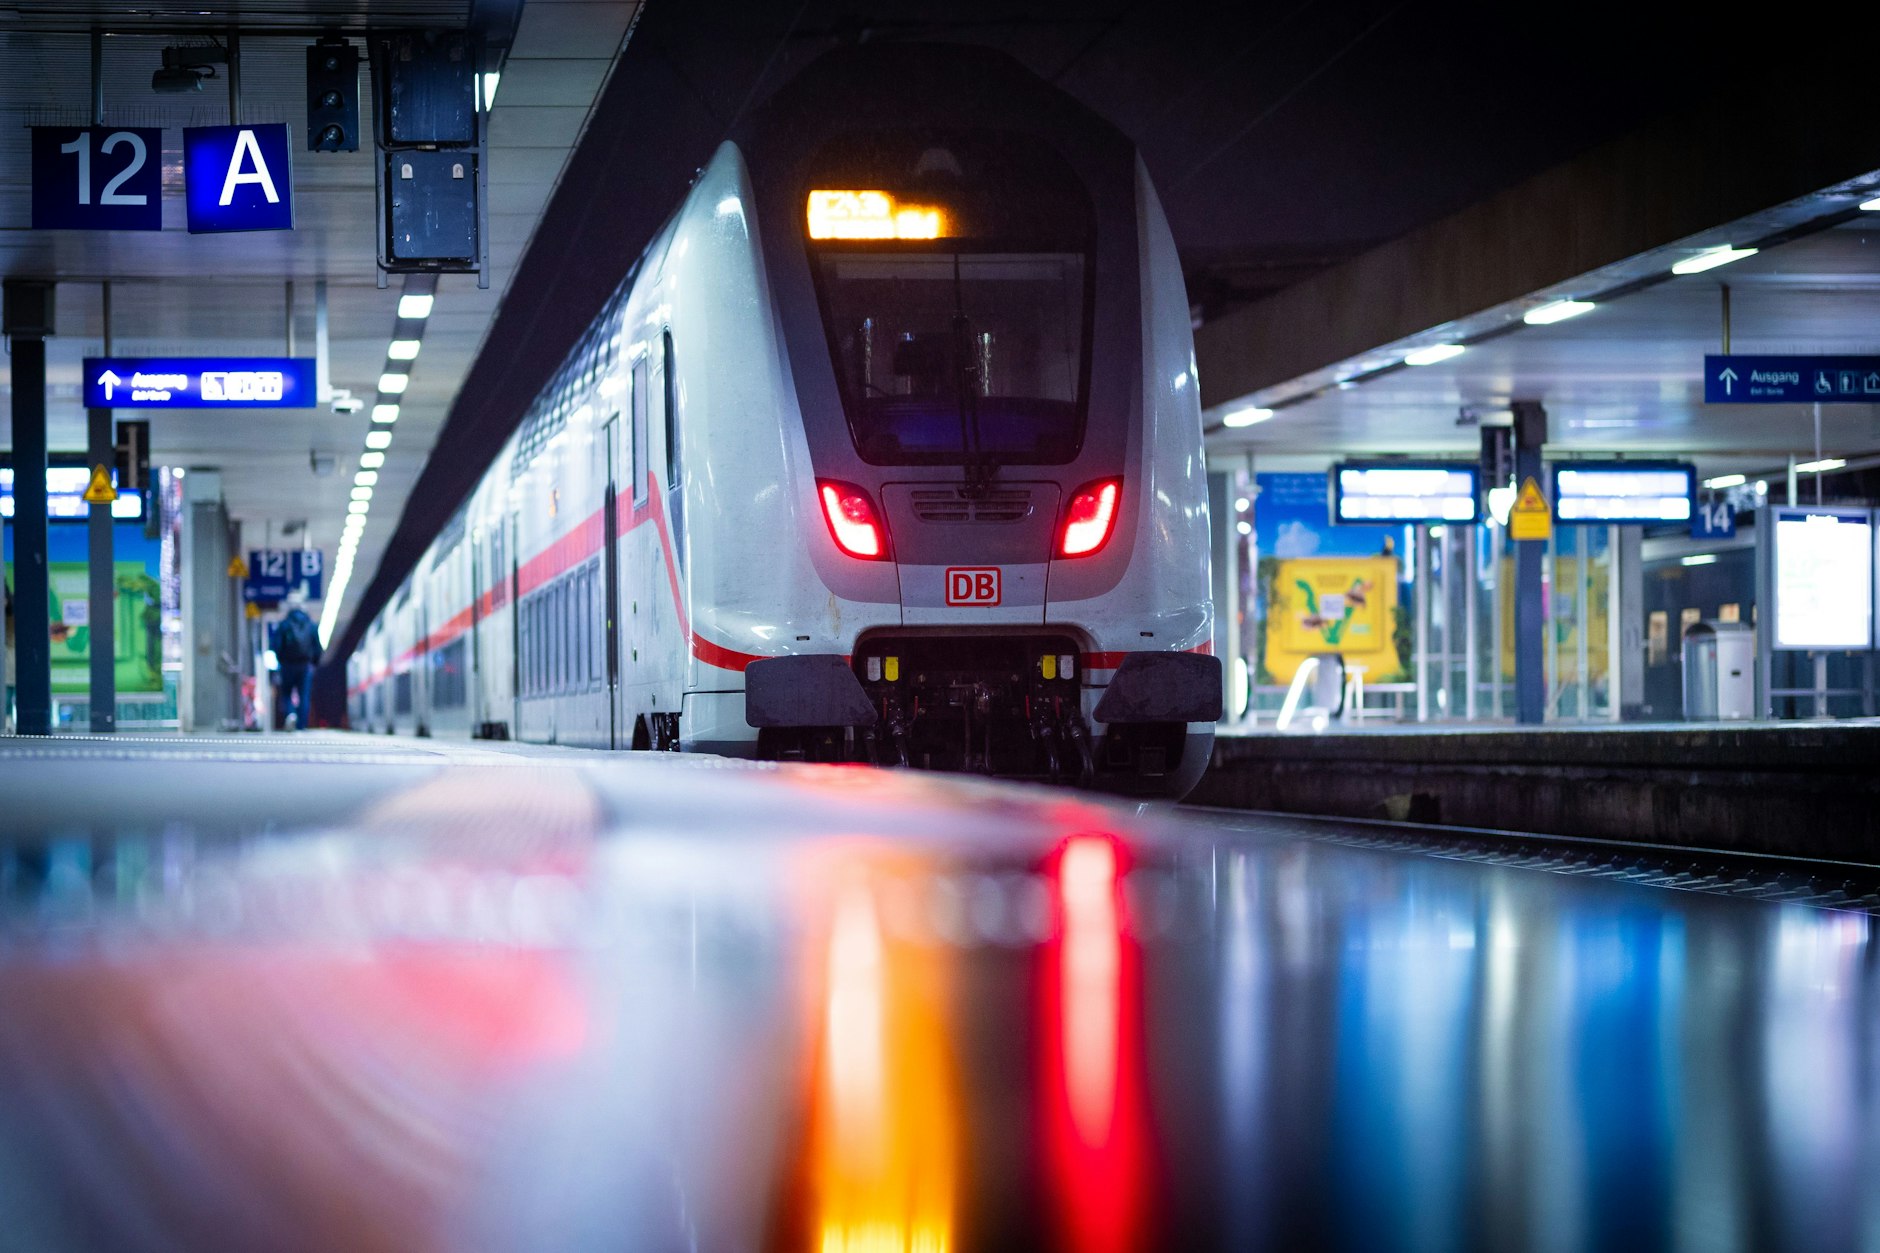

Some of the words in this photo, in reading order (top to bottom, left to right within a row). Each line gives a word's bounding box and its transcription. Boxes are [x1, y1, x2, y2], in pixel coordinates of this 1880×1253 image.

[61, 132, 147, 205] 12
[219, 130, 280, 205] A
[1750, 369, 1799, 385] Ausgang
[1699, 503, 1731, 533] 14
[257, 550, 285, 577] 12
[301, 549, 320, 577] B
[953, 573, 995, 600] DB
